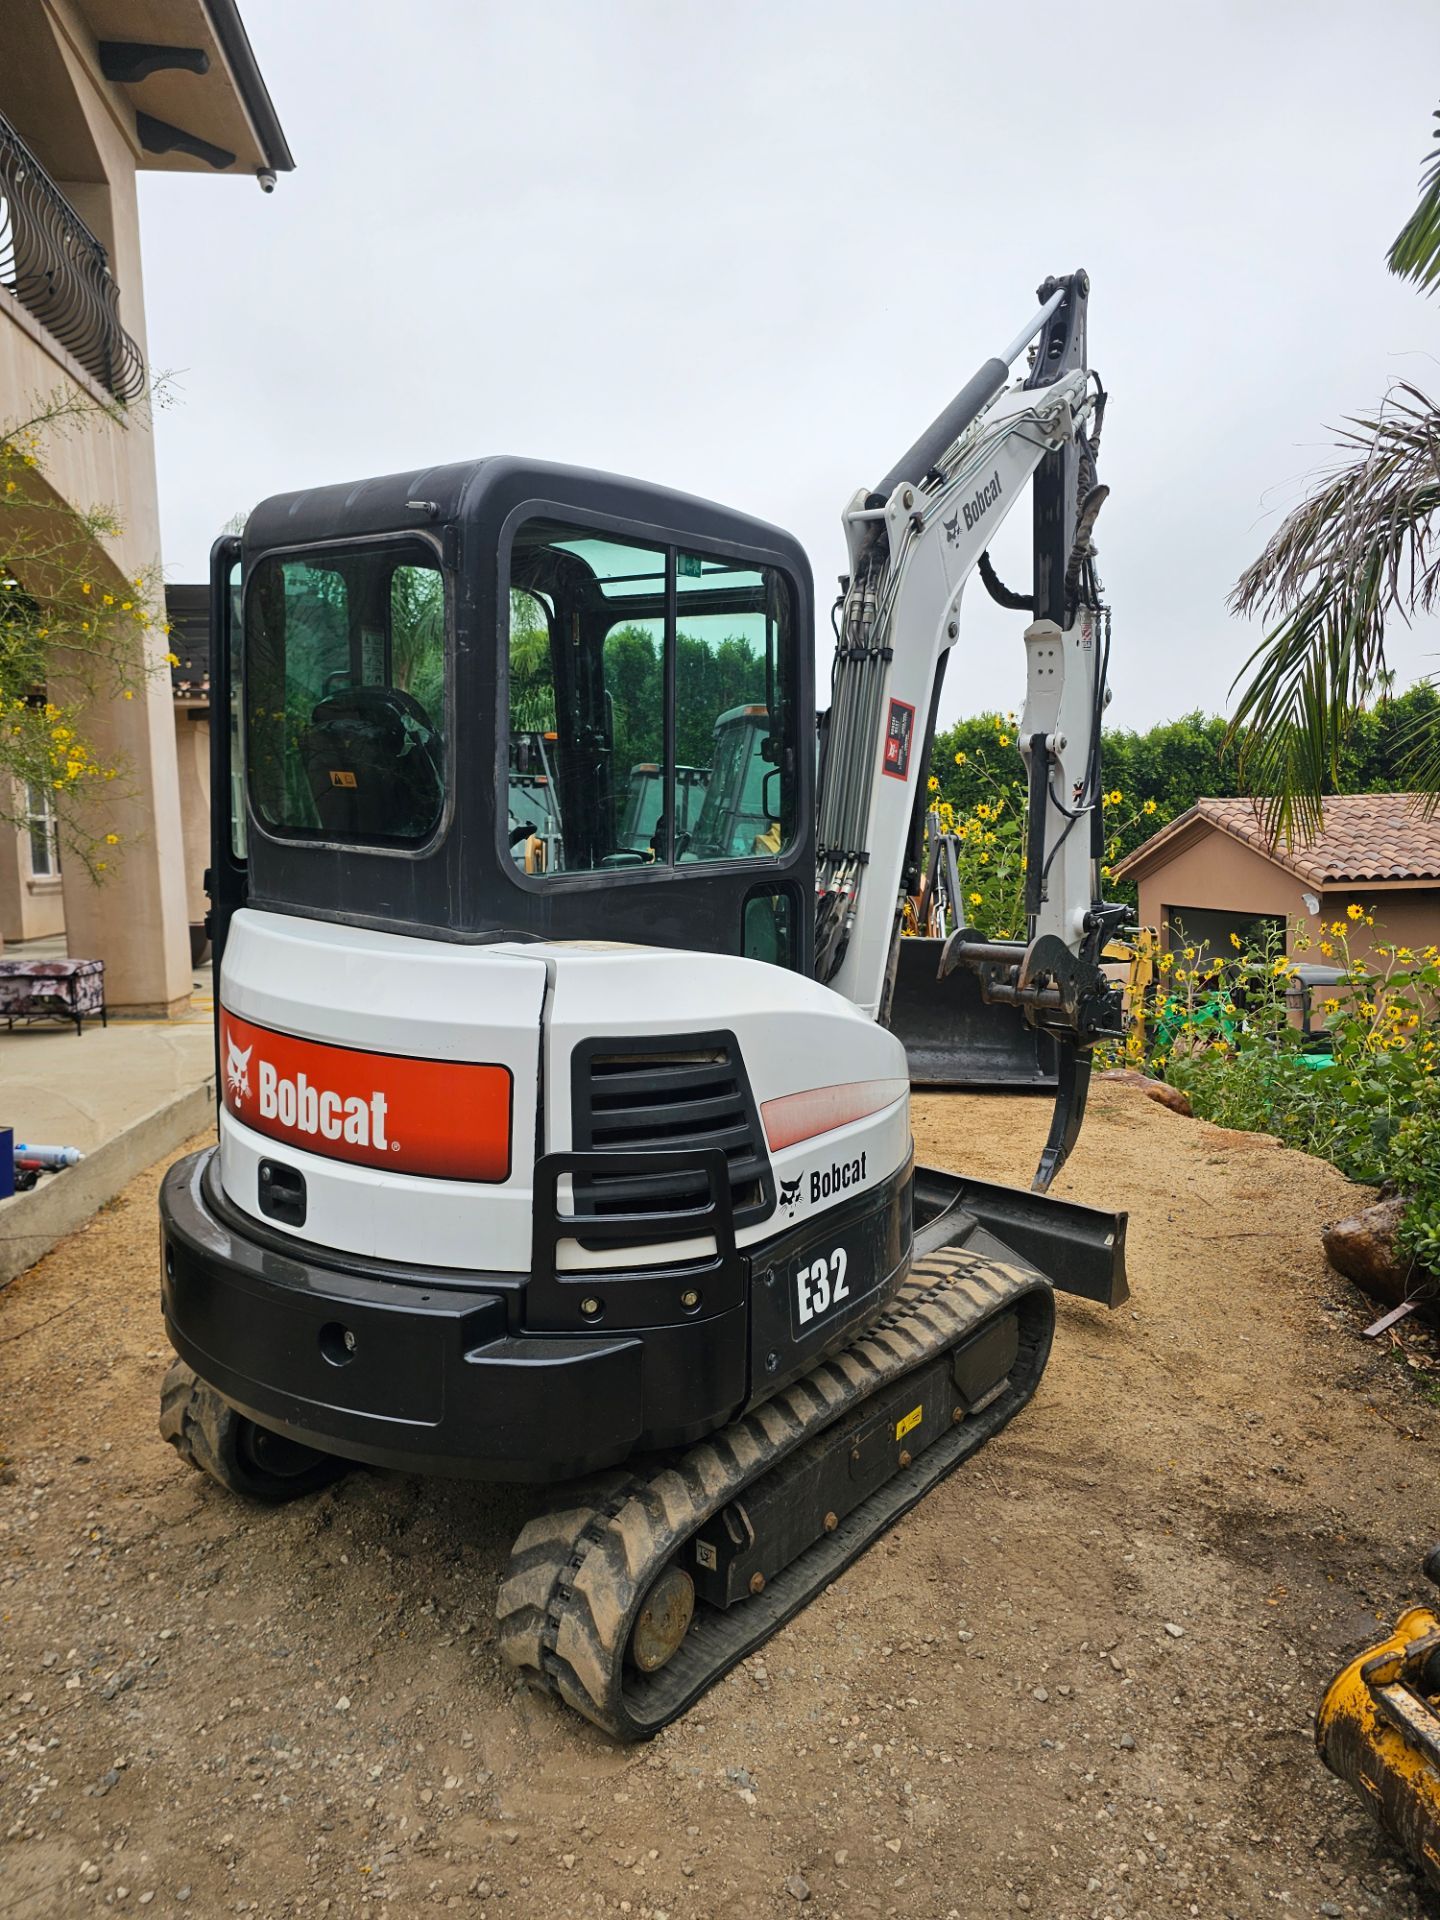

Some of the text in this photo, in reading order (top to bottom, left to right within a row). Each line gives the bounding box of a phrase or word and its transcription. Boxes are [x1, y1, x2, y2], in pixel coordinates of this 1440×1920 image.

[962, 470, 1002, 532] Bobcat
[258, 1060, 388, 1150] Bobcat
[809, 1151, 867, 1204] Bobcat
[796, 1247, 850, 1325] E32
